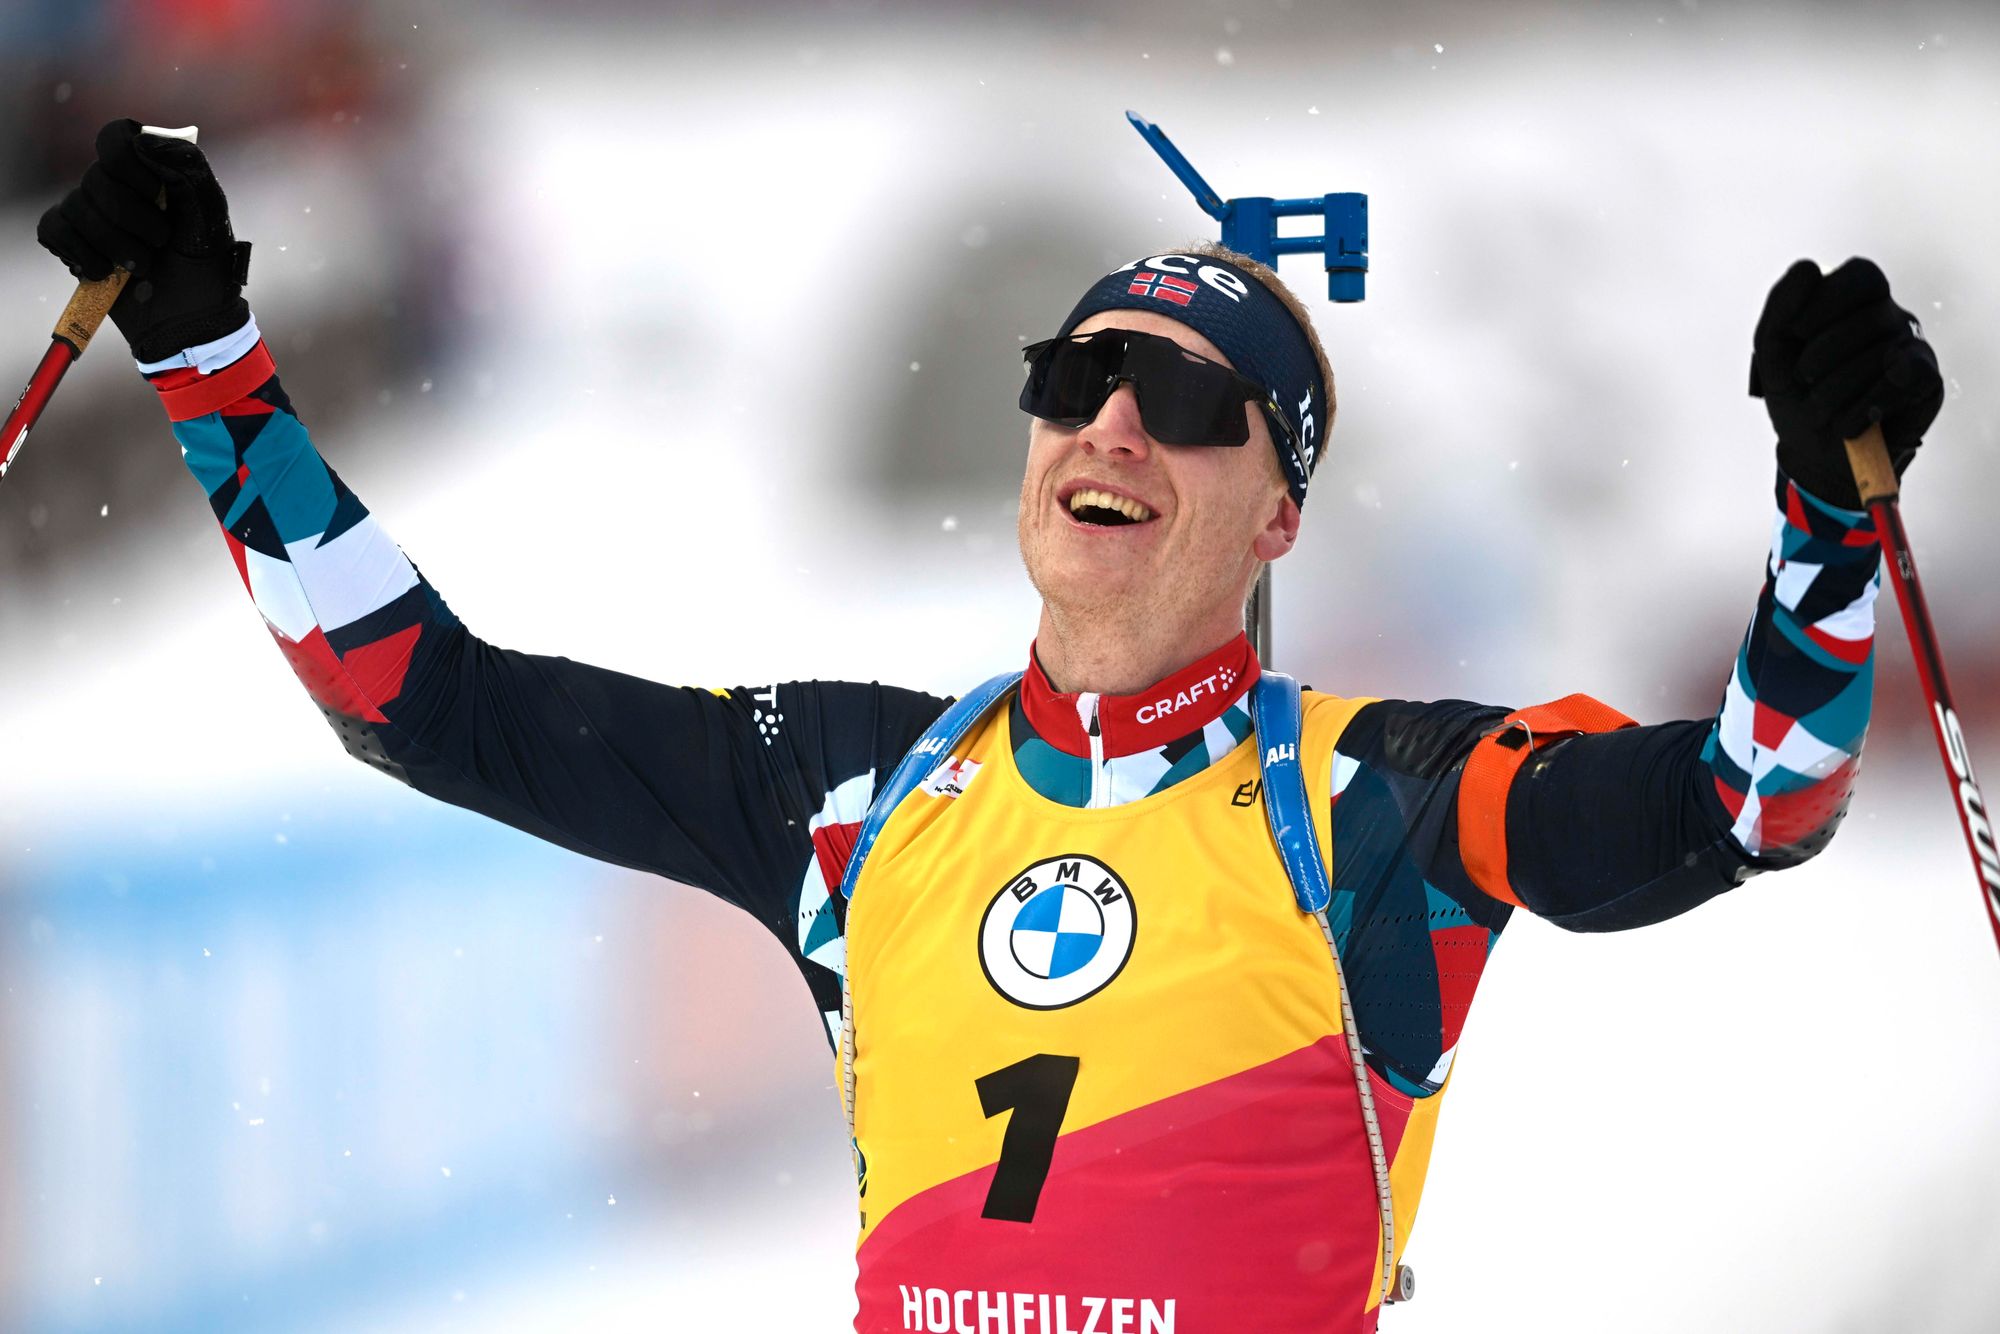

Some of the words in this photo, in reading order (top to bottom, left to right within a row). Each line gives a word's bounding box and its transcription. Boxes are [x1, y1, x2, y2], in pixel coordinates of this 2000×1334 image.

[1135, 675, 1217, 725] CRAFT
[1010, 861, 1123, 906] BMW
[975, 1053, 1080, 1223] 1
[899, 1284, 1176, 1334] HOCHFILZEN
